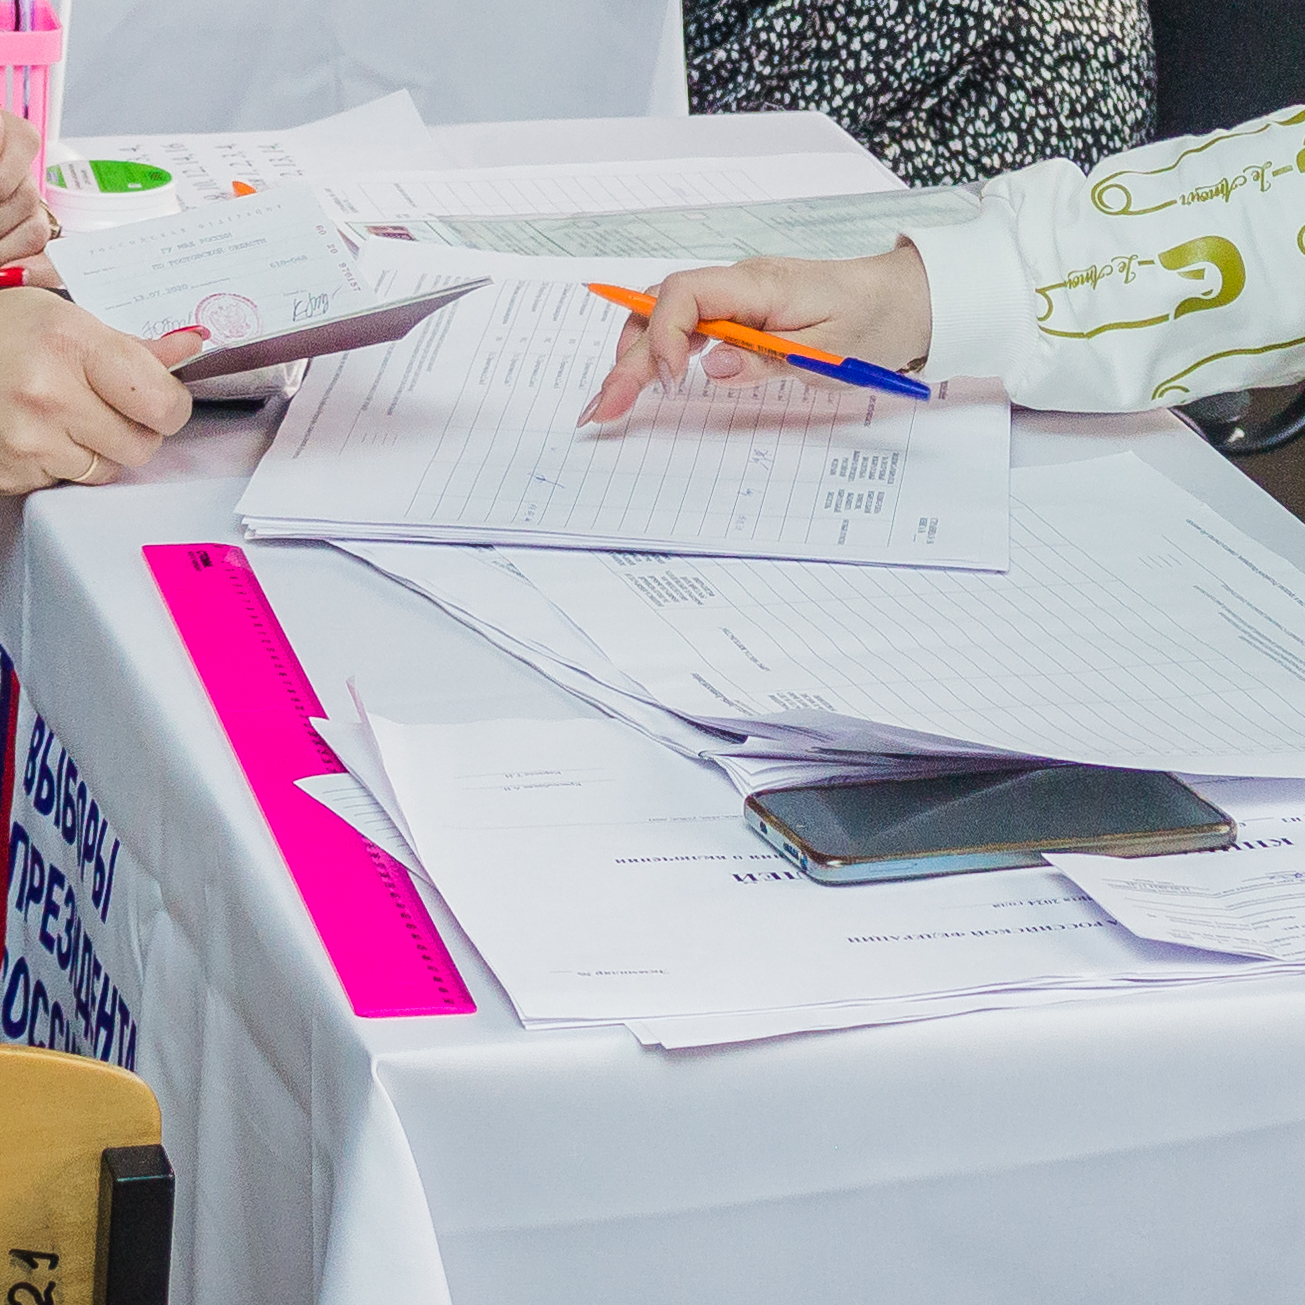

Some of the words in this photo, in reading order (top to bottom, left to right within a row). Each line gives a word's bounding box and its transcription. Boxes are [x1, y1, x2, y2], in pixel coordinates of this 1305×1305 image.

[1179, 176, 1248, 207] Amour
[23, 712, 122, 924] ВЫБОРЫ
[613, 854, 728, 865] включении
[847, 928, 966, 945] ФЕДЕРАЦИИ
[967, 918, 1104, 941] РОССИЙСКОЙ
